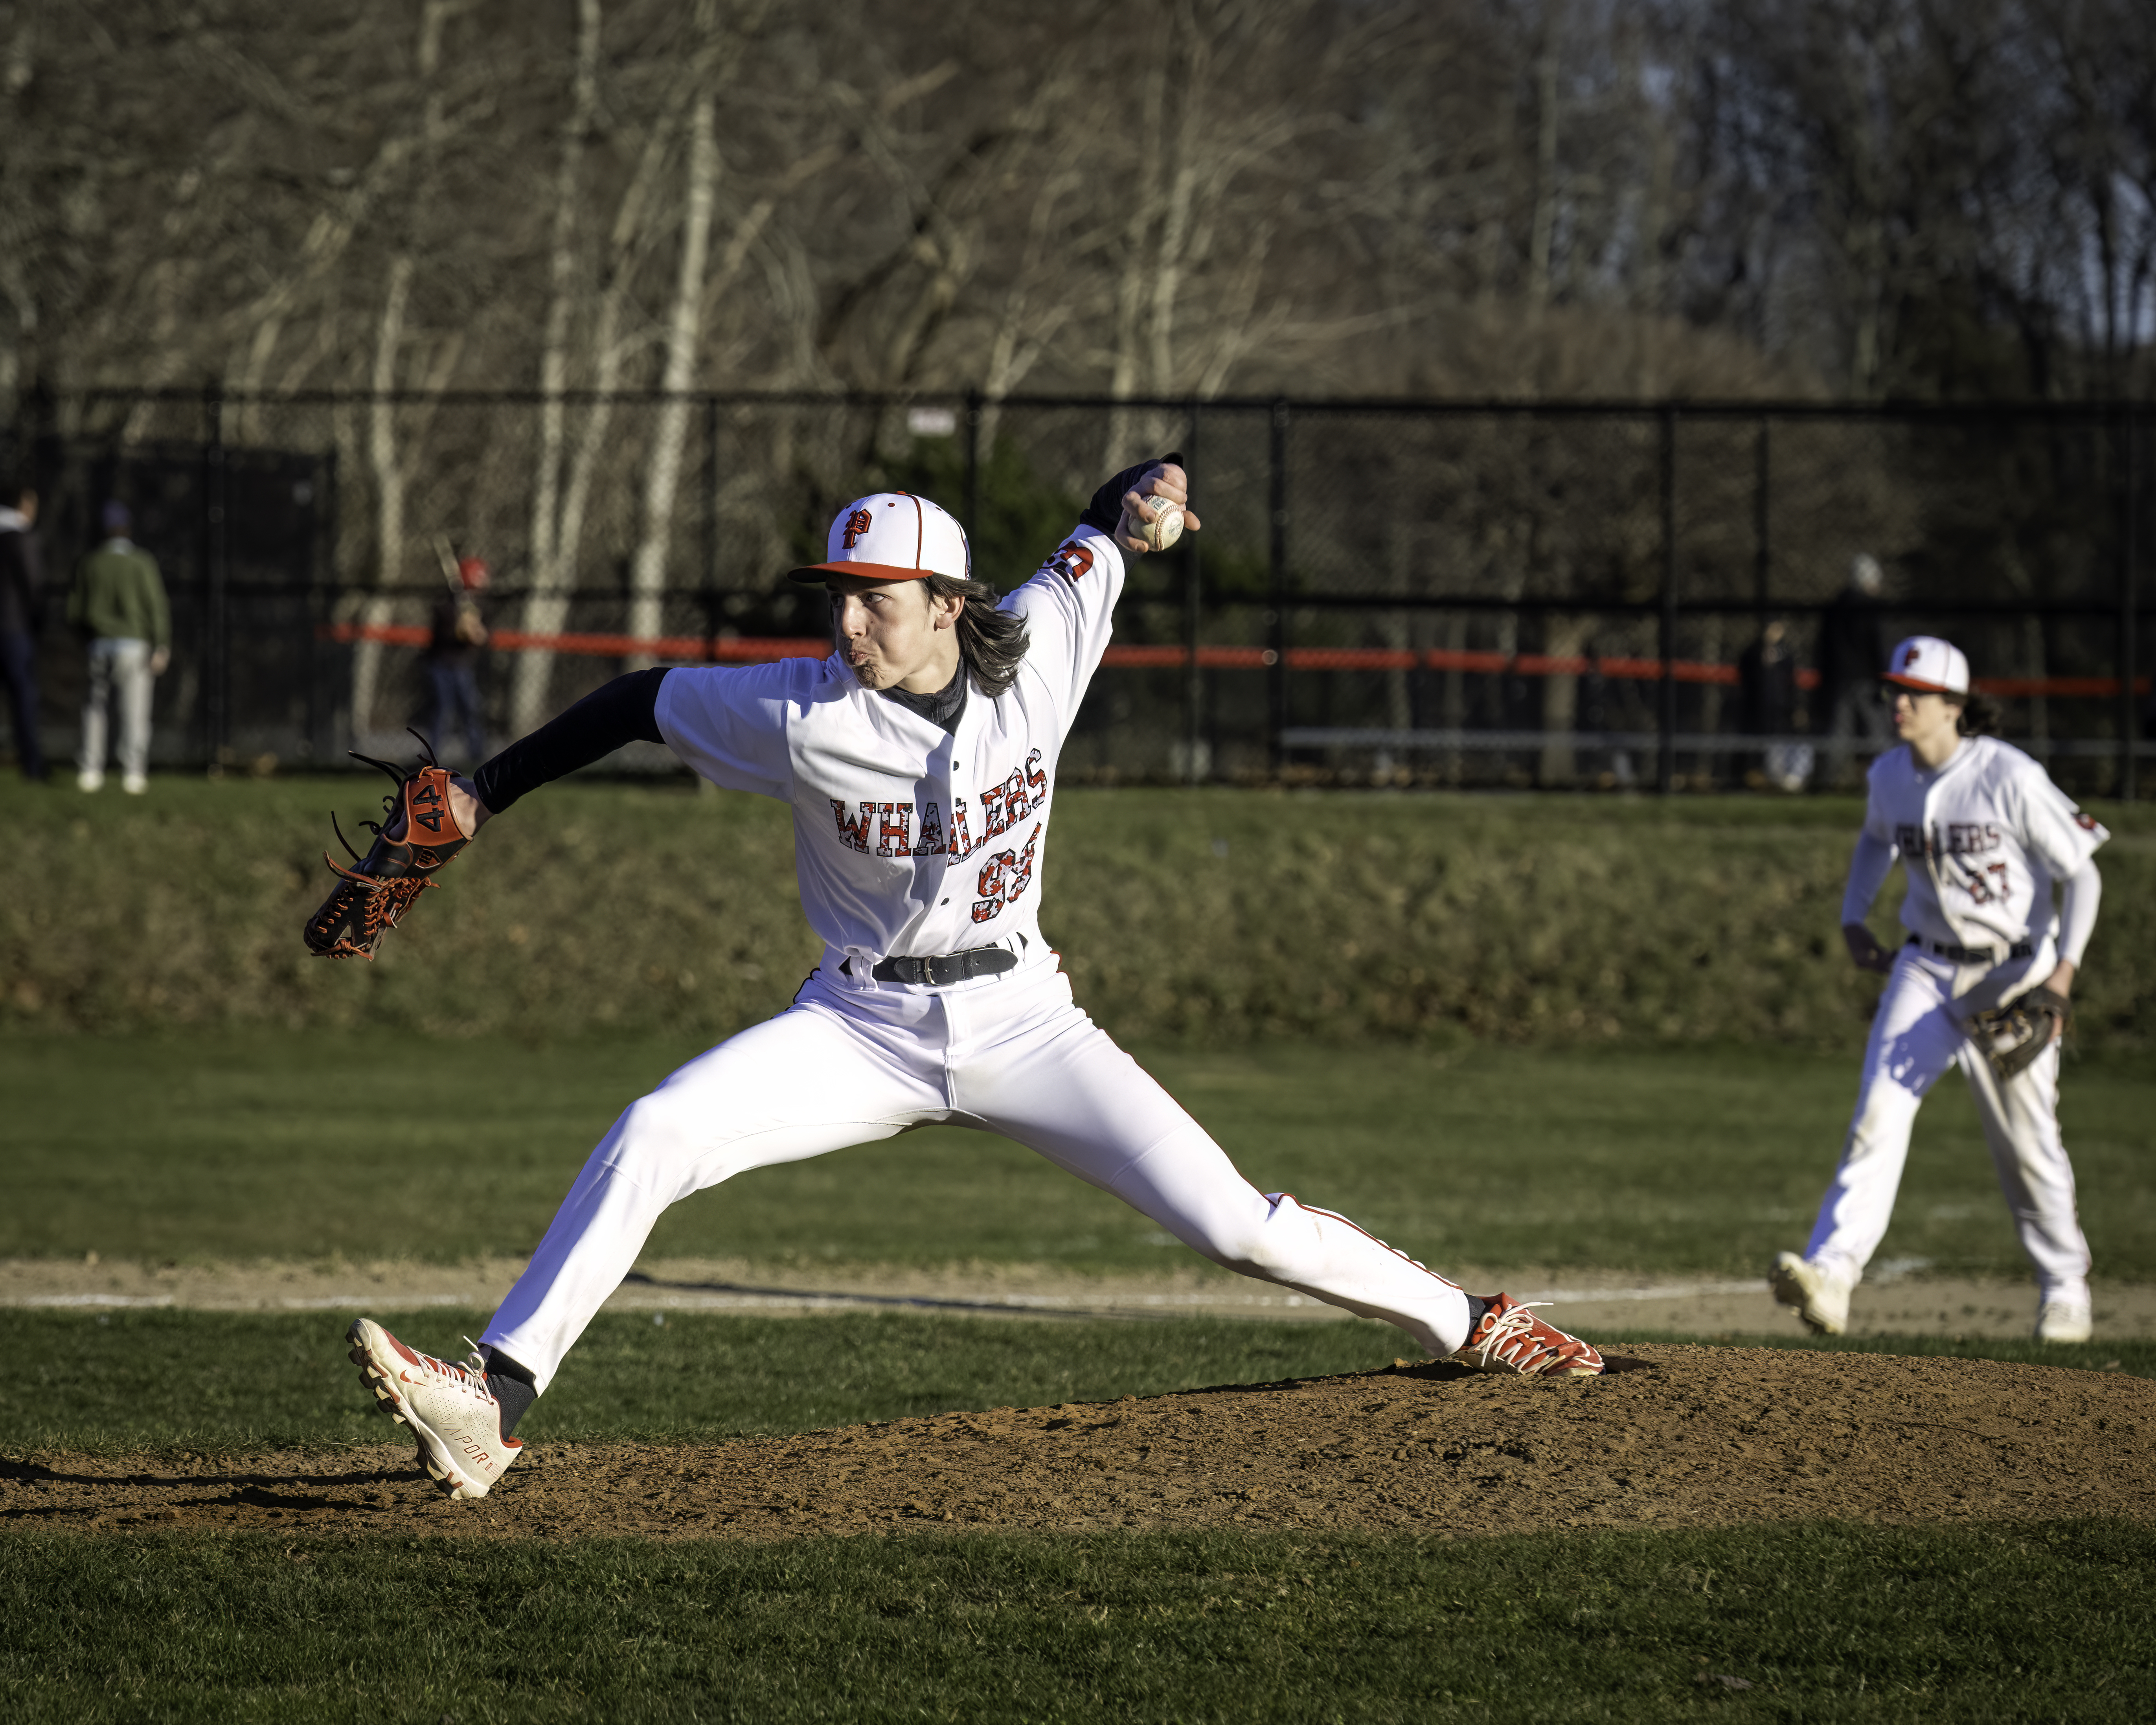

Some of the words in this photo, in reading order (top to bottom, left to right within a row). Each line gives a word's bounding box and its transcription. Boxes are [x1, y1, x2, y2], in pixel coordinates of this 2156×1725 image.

[841, 508, 872, 550] P
[413, 784, 445, 833] 44
[830, 747, 1047, 867] WHALERS
[439, 1417, 489, 1464] VAPOR
